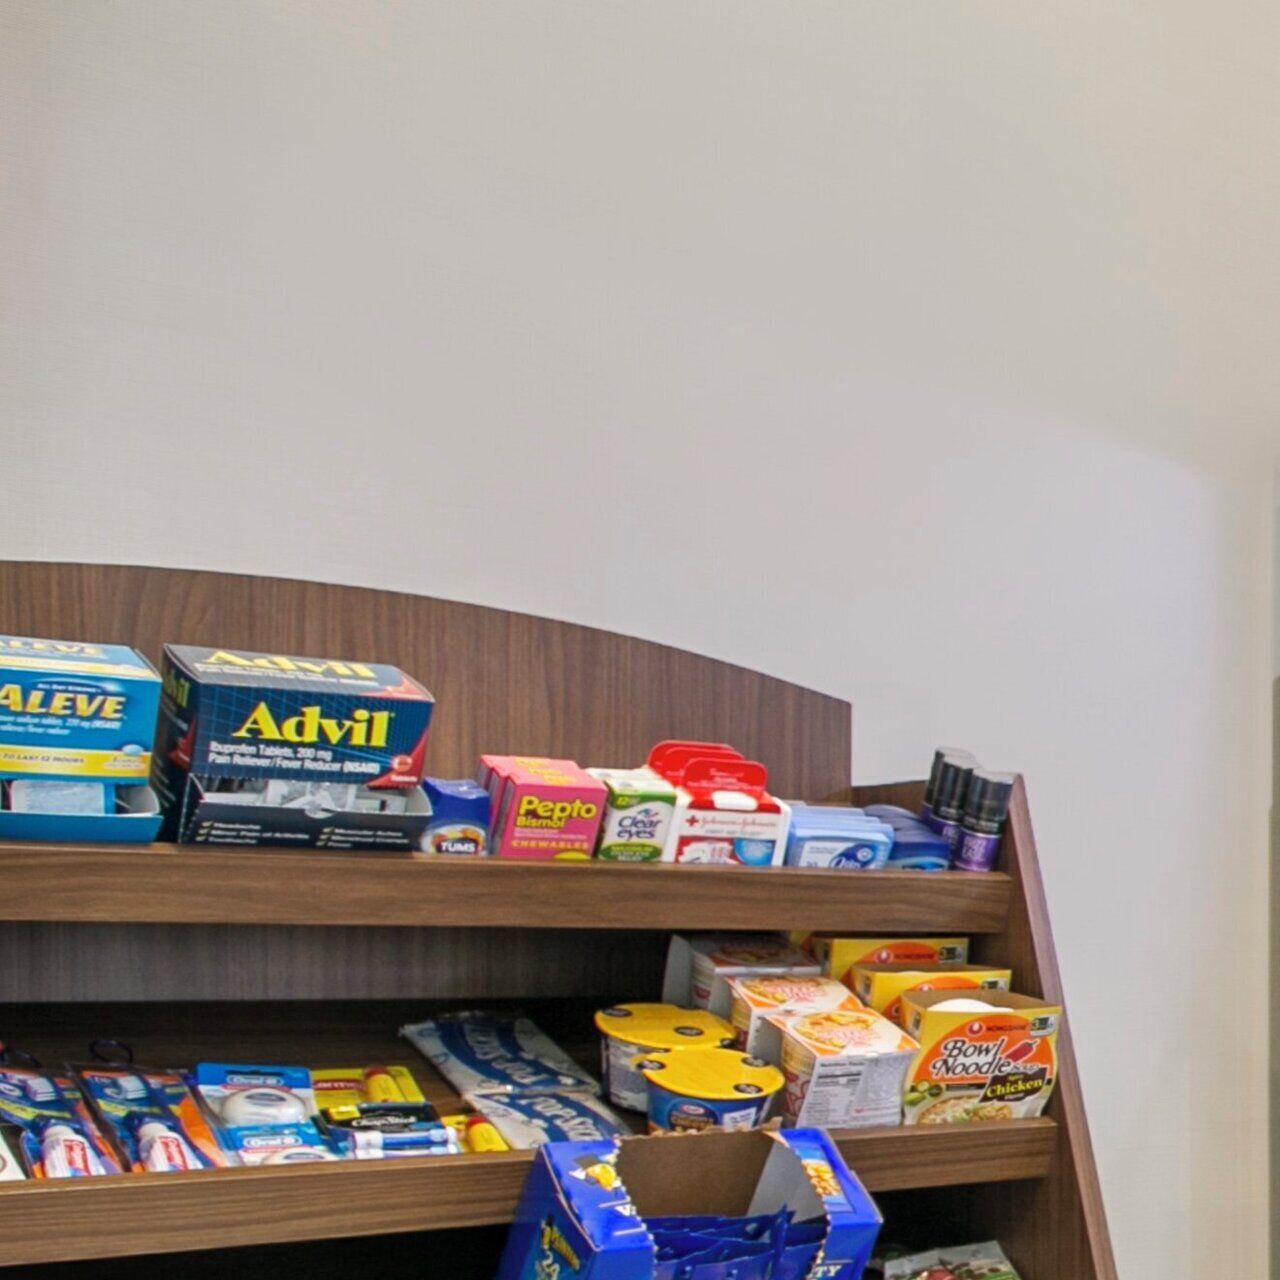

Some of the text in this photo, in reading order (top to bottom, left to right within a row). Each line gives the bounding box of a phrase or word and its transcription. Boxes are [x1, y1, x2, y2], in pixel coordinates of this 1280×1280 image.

[202, 651, 377, 678] Advil
[0, 684, 126, 719] ALEVE
[231, 701, 388, 748] Advil
[208, 752, 231, 764] Pain
[303, 758, 341, 772] Reducer
[209, 741, 257, 756] Ibuprofen
[297, 748, 315, 759] 200
[316, 750, 333, 762] mg
[518, 796, 597, 819] Pepto
[516, 815, 567, 829] Bismol
[618, 814, 661, 830] Clear
[616, 827, 656, 841] eyes
[440, 841, 476, 852] TUMS
[943, 1037, 1004, 1059] Bowl
[932, 1052, 1011, 1077] Noodle
[986, 1079, 1043, 1099] Chicken
